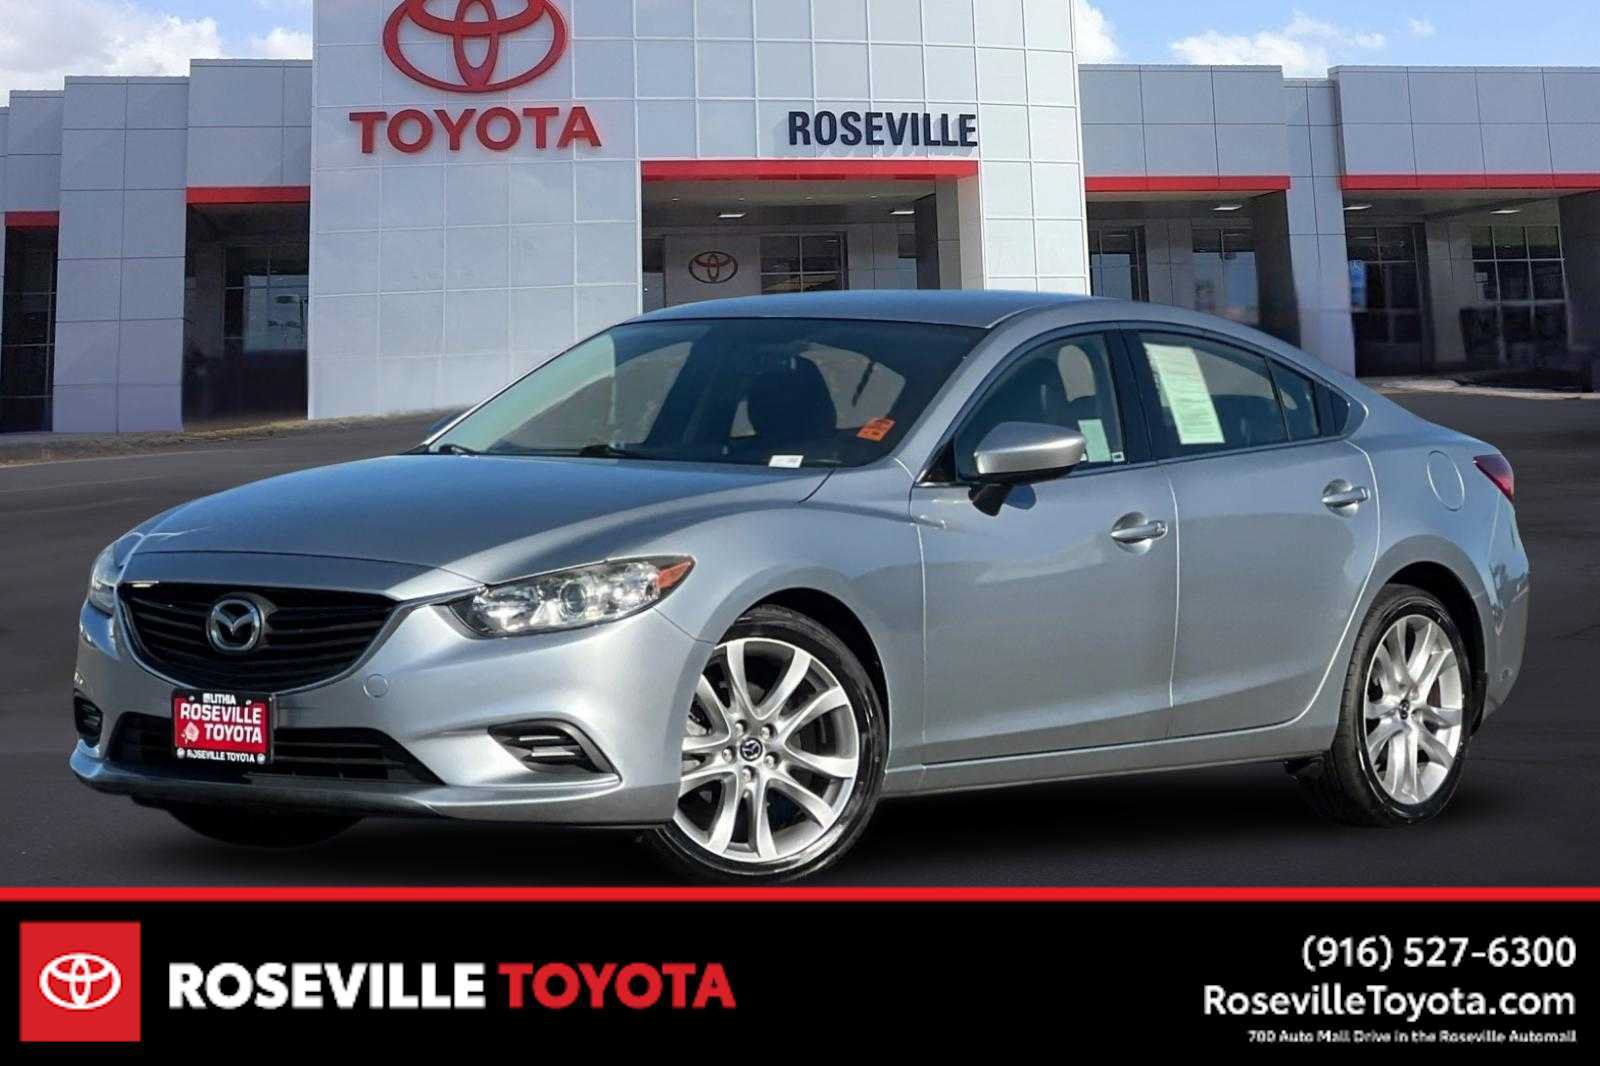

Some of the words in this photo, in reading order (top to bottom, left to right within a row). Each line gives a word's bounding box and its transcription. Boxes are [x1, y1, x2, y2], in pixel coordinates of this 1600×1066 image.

[349, 106, 602, 153] TOYOTA
[789, 111, 978, 147] ROSEVILLE
[210, 693, 236, 705] LITHIA
[180, 703, 262, 724] ROSEVILLE
[204, 723, 262, 743] TOYOTA
[186, 749, 225, 760] ROSEVILLE
[227, 751, 255, 763] TOYOTA
